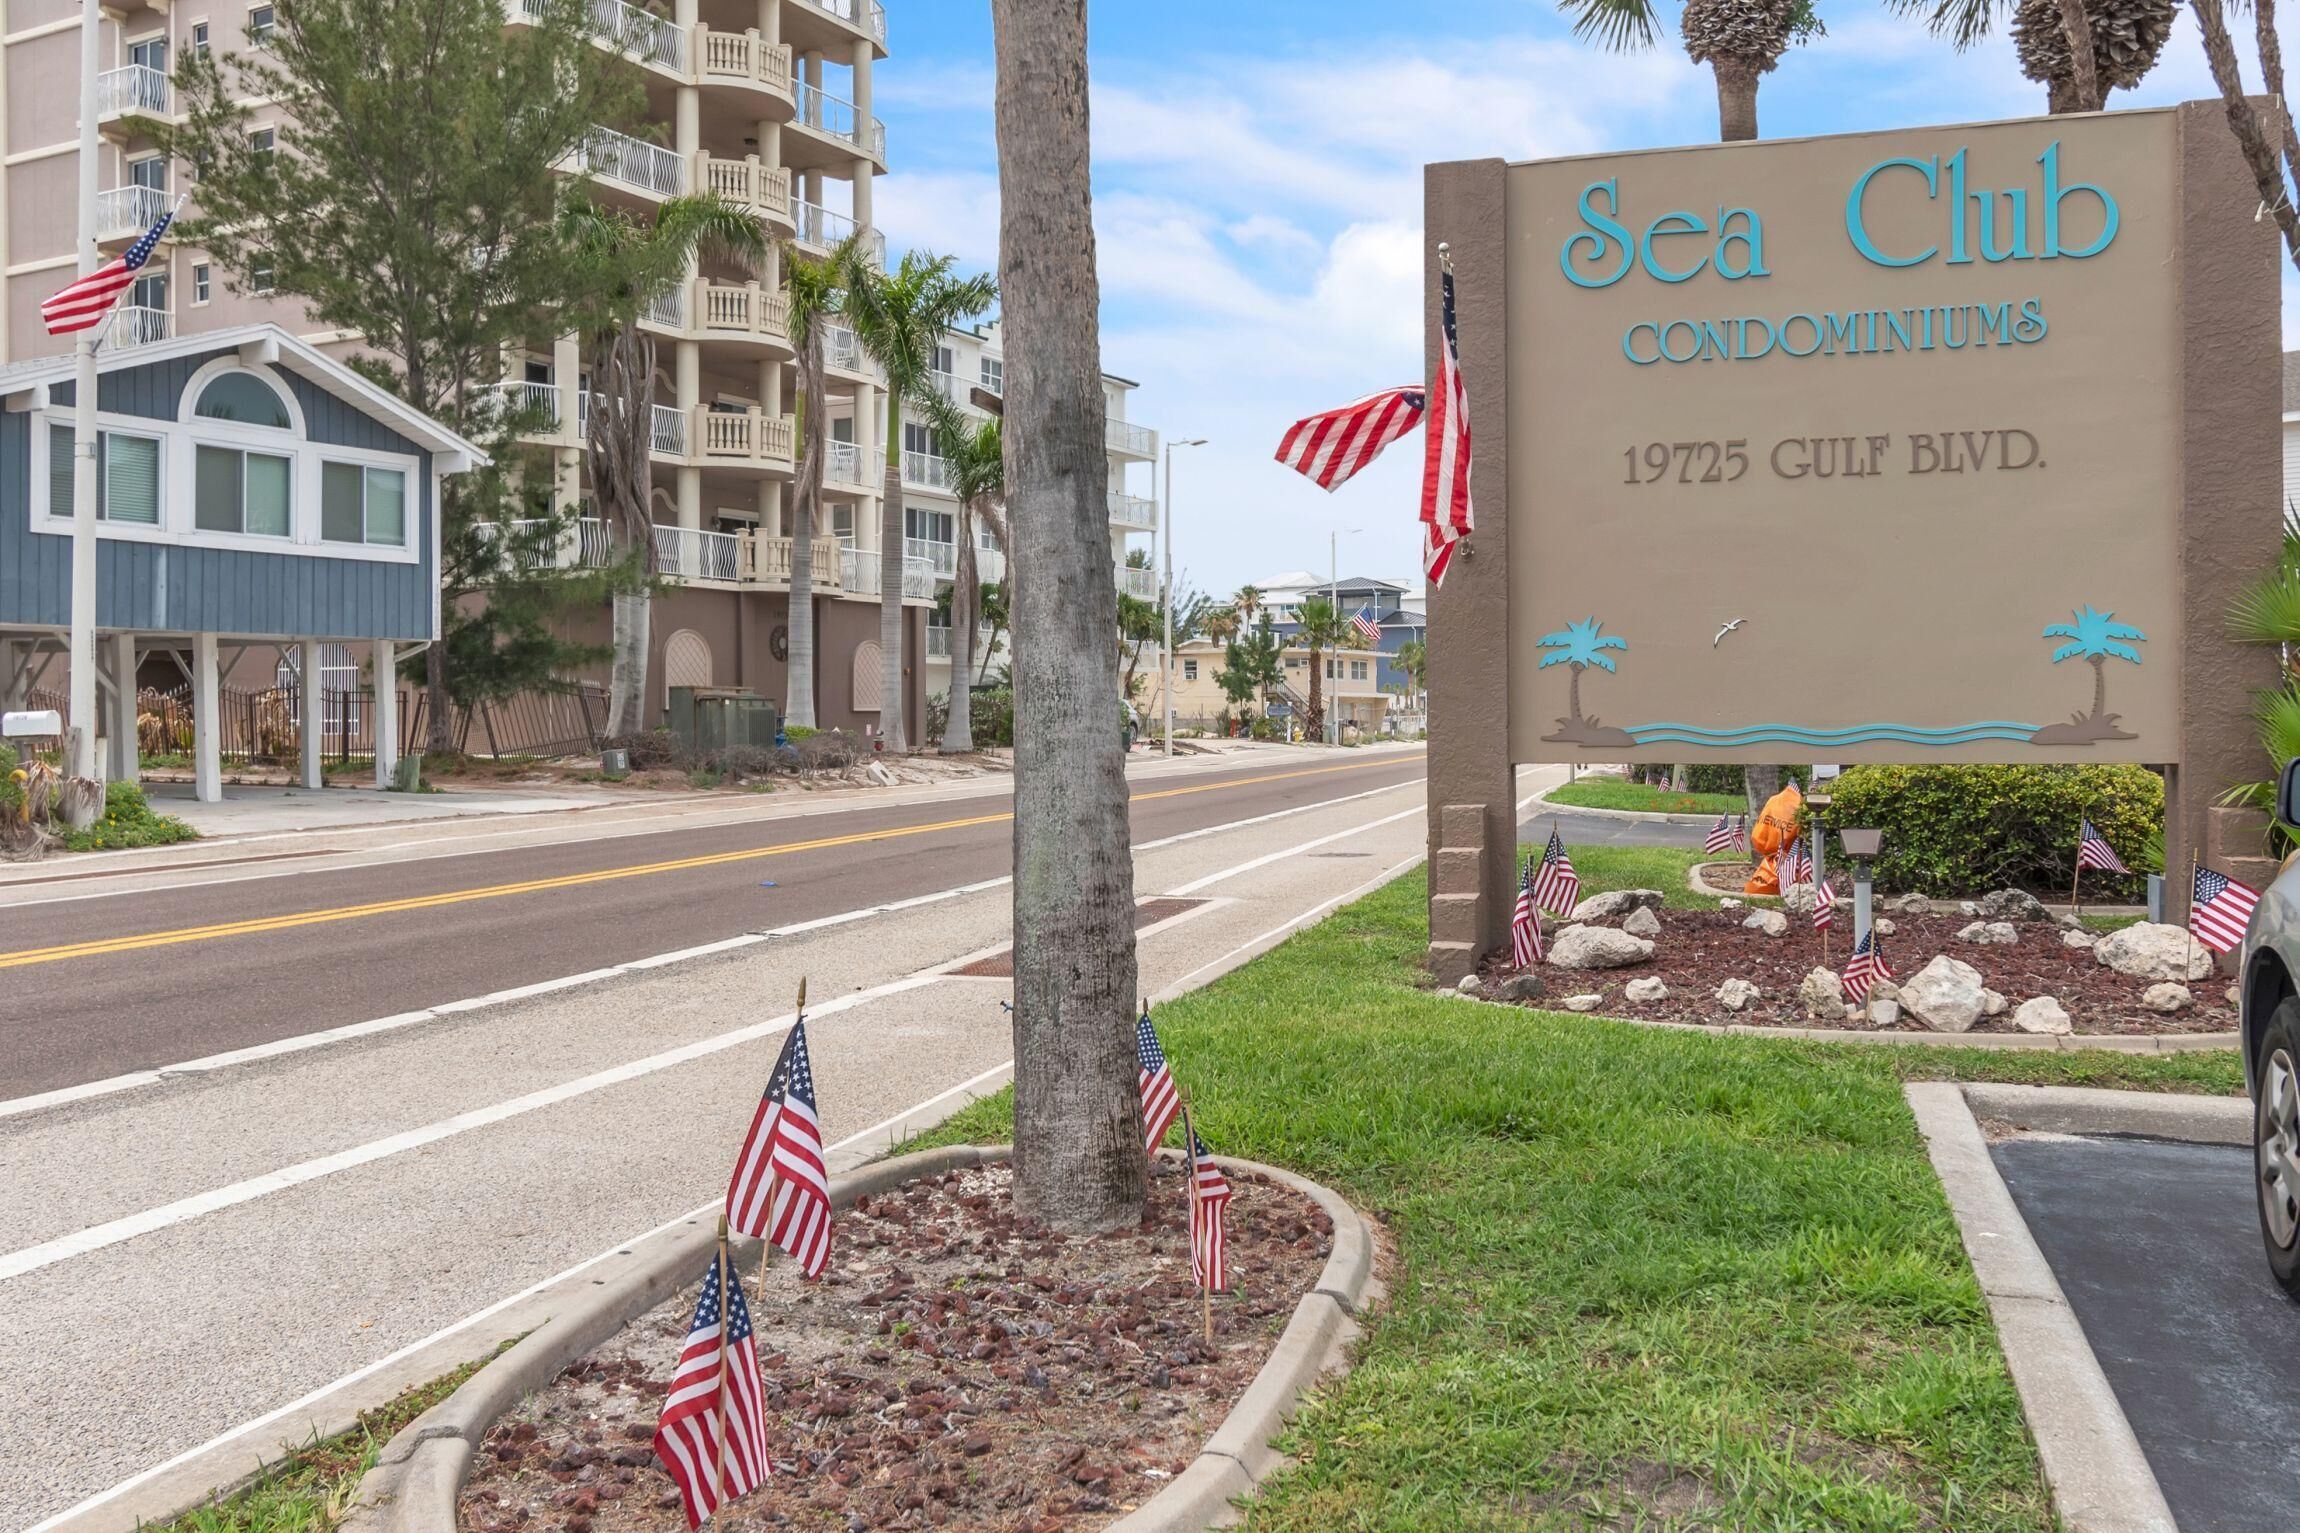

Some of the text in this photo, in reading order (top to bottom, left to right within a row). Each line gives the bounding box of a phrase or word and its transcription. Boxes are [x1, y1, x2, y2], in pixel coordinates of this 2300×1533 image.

[1560, 139, 2121, 289] Sea Club
[1622, 296, 2048, 365] CONDOMINIUMS
[1622, 428, 2047, 486] 19725 GULF BLVD.
